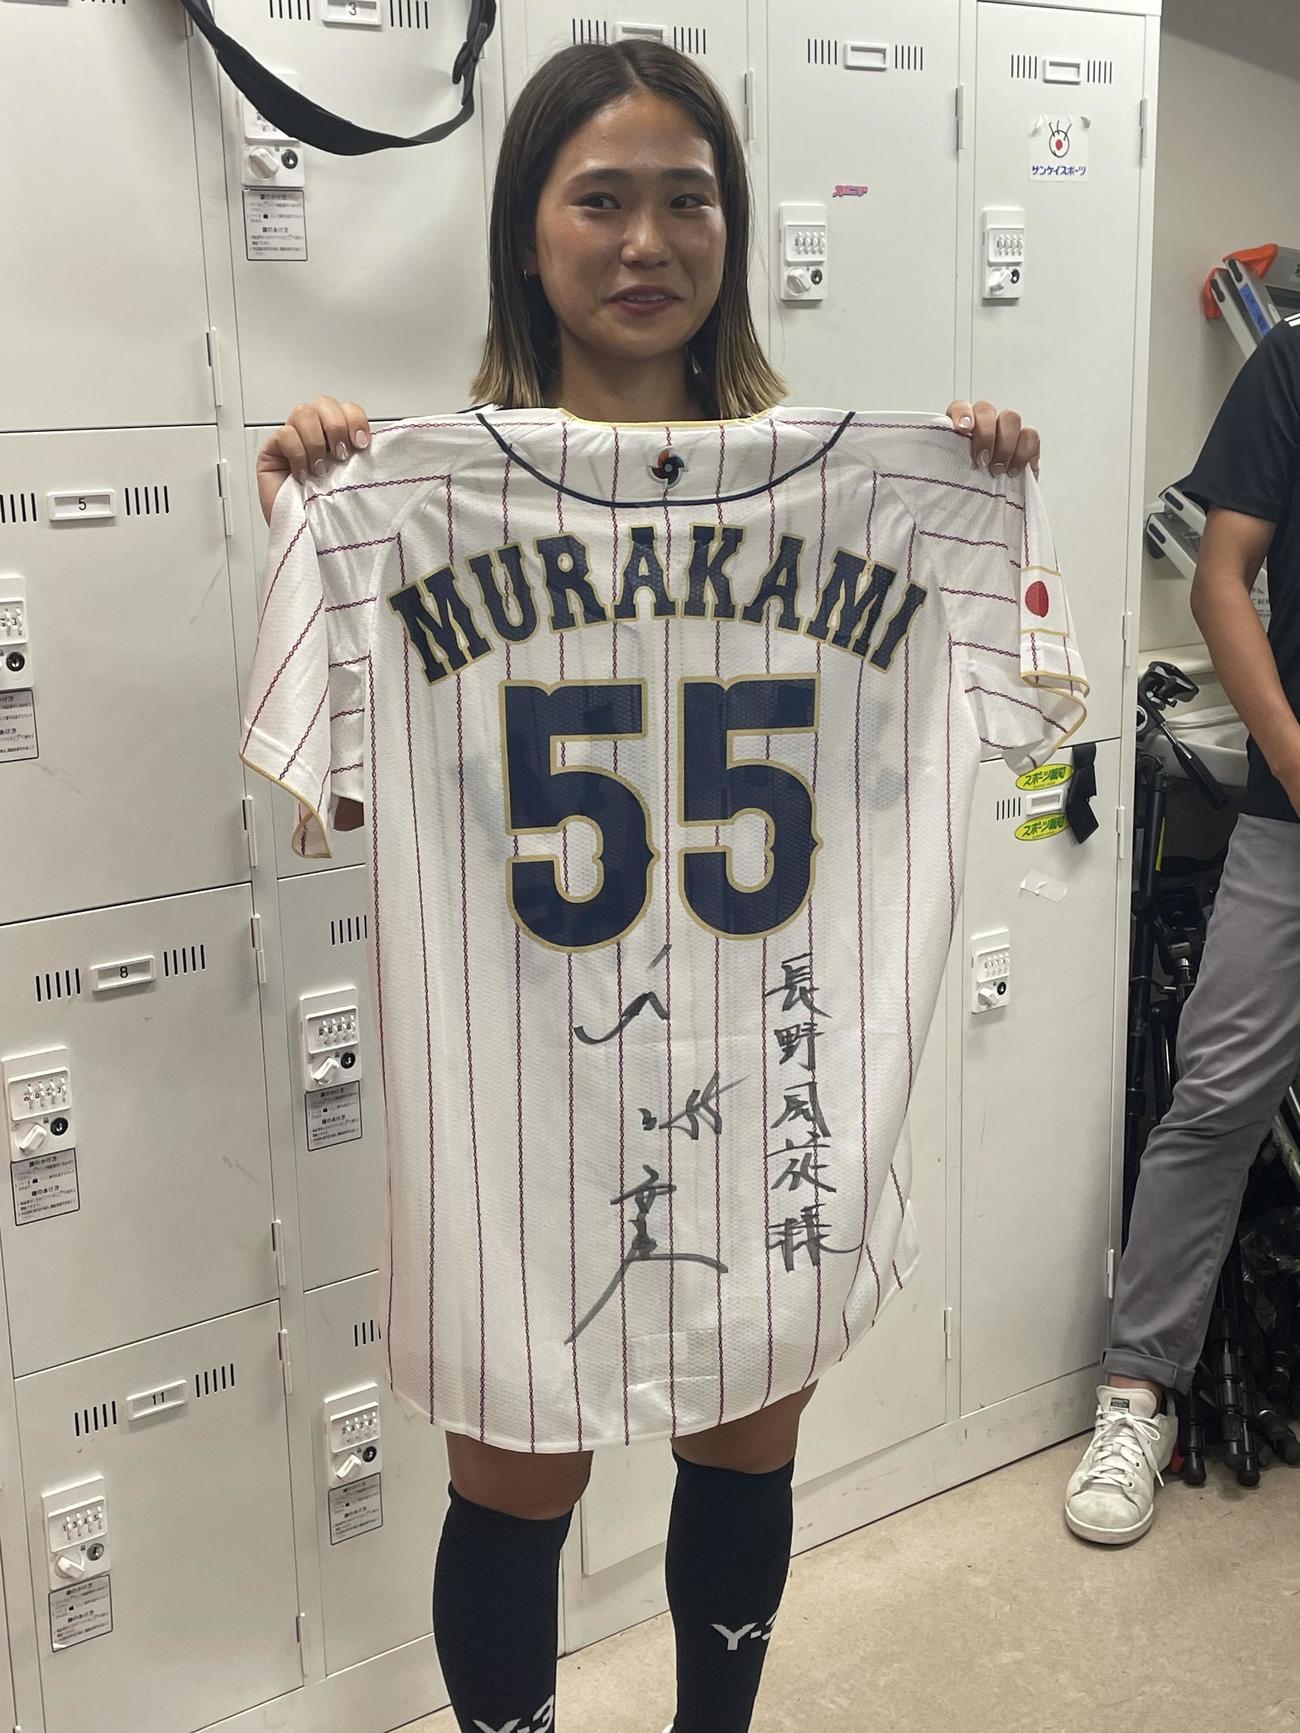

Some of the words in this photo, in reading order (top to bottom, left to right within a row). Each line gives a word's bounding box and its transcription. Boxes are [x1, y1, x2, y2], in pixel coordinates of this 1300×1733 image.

[349, 1, 357, 16] 3
[1031, 165, 1087, 176] サンケイスポーツ
[78, 497, 87, 511] 5
[389, 522, 928, 686] MURAKAMI
[498, 672, 824, 953] 55
[119, 965, 129, 979] 8
[152, 1391, 165, 1406] 11
